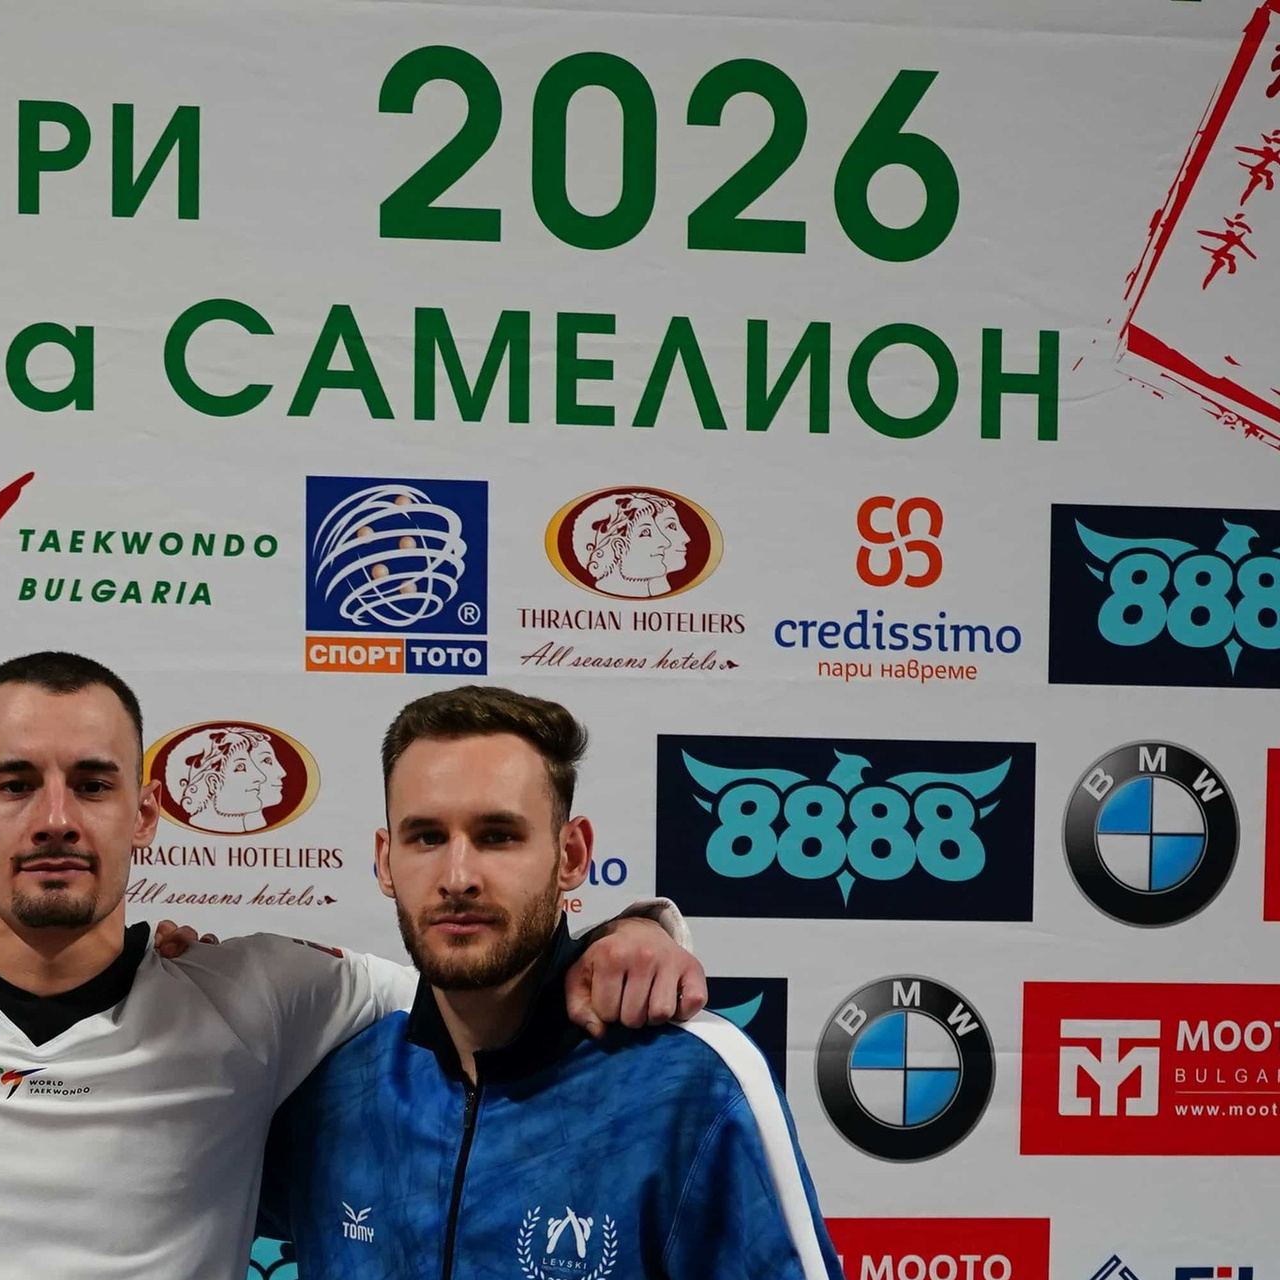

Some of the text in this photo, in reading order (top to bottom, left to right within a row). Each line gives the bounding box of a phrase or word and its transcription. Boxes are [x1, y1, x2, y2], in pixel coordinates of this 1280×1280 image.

[379, 45, 959, 262] 2026
[164, 299, 1059, 441] САМЕЛИОН
[19, 529, 277, 558] TAEKWONDO
[19, 578, 211, 605] BULGARIA
[518, 609, 745, 633] THRACIAN HOTELIERS
[775, 610, 1021, 653] credissimo
[310, 645, 481, 667] СПОРТ ТОТО
[521, 642, 716, 670] All seasons hotels
[819, 660, 977, 684] пари навреме
[1082, 747, 1223, 802] BMW
[705, 784, 986, 882] 8888
[130, 847, 342, 868] RACIAN HOTELIERS
[164, 894, 242, 904] seasons
[250, 884, 313, 905] hotels
[835, 981, 980, 1038] BMW
[1177, 1020, 1280, 1051] MOO
[1176, 1069, 1280, 1083] BULGA
[30, 1087, 90, 1095] TAEKWONDO
[1175, 1103, 1277, 1116] www.moot
[343, 1222, 375, 1243] TOMY
[543, 1258, 586, 1269] LEVSKI
